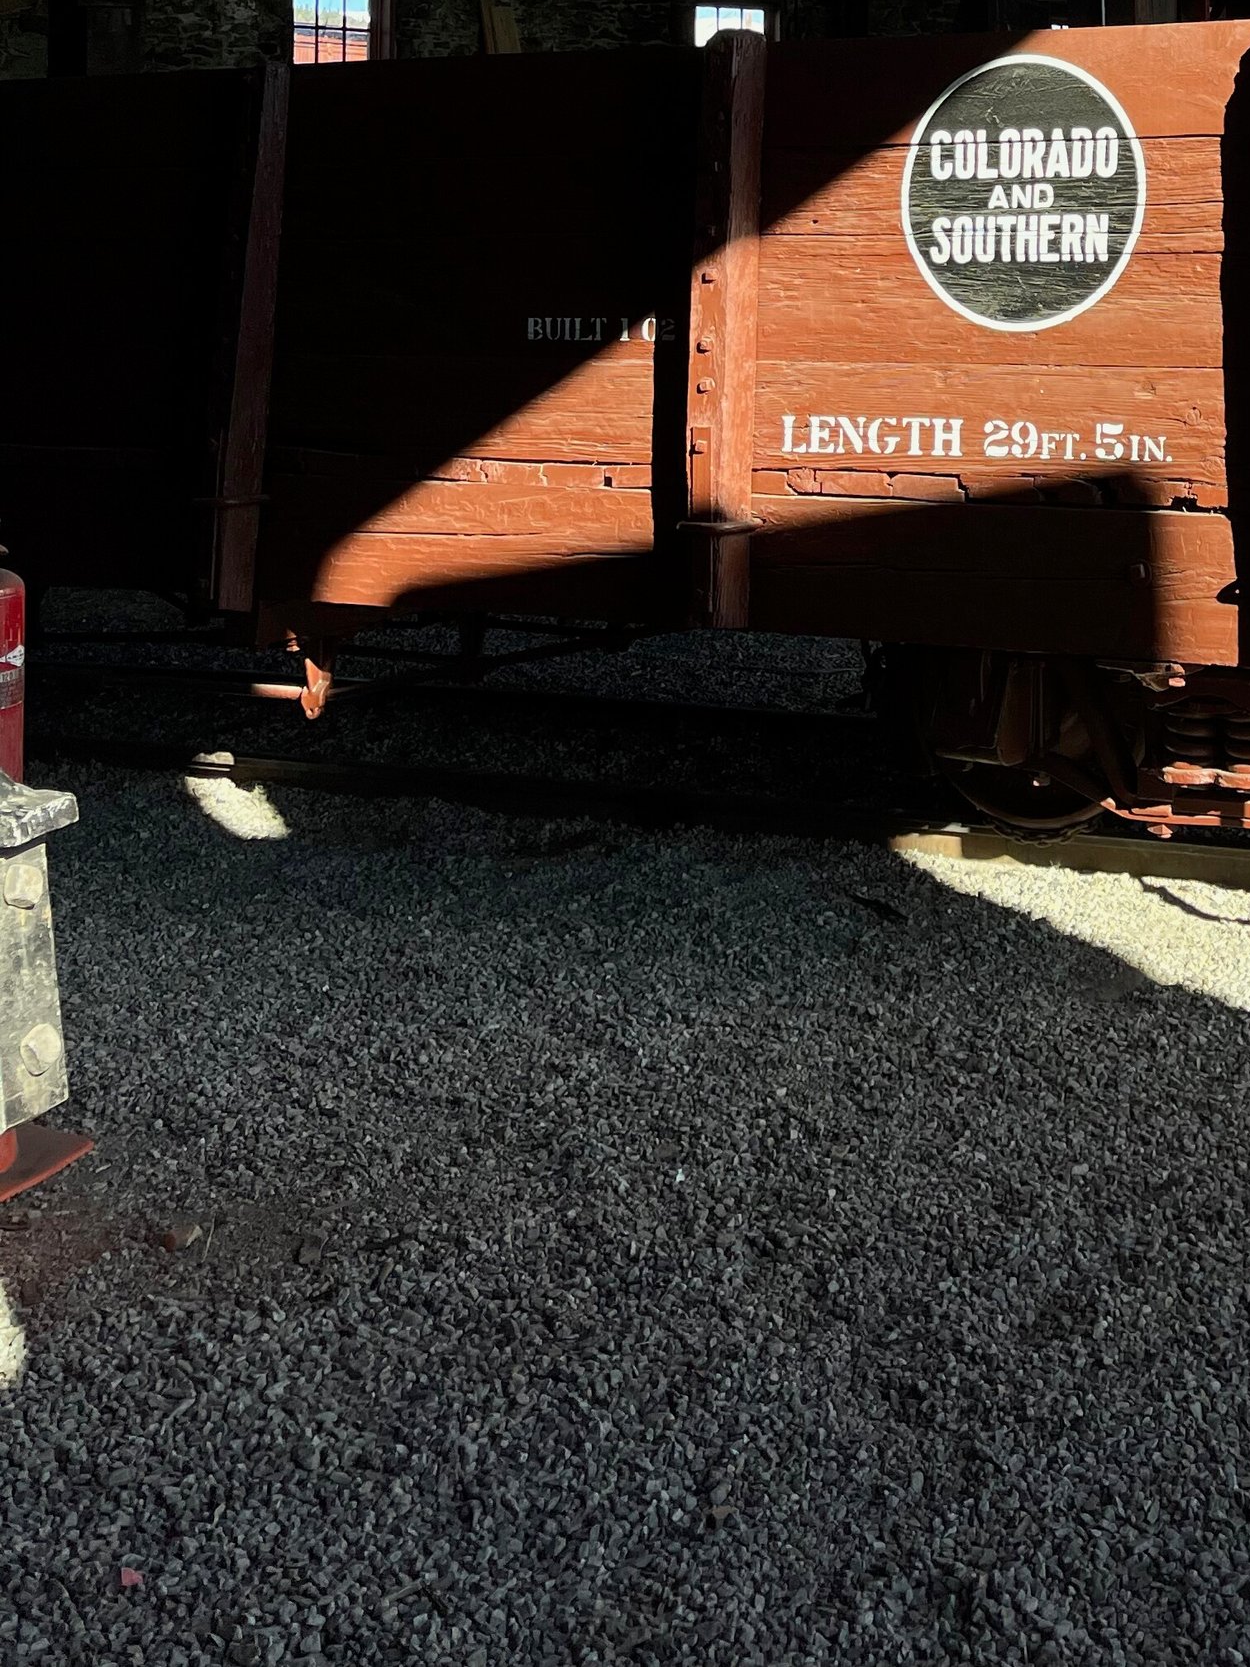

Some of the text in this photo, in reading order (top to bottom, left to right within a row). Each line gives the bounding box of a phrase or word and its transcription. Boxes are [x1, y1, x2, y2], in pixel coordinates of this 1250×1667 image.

[930, 127, 1119, 181] COLORADO
[988, 184, 1054, 209] AND
[930, 214, 1109, 264] SOUTHERN
[527, 317, 607, 341] BUILT
[781, 414, 963, 456] LENGTH
